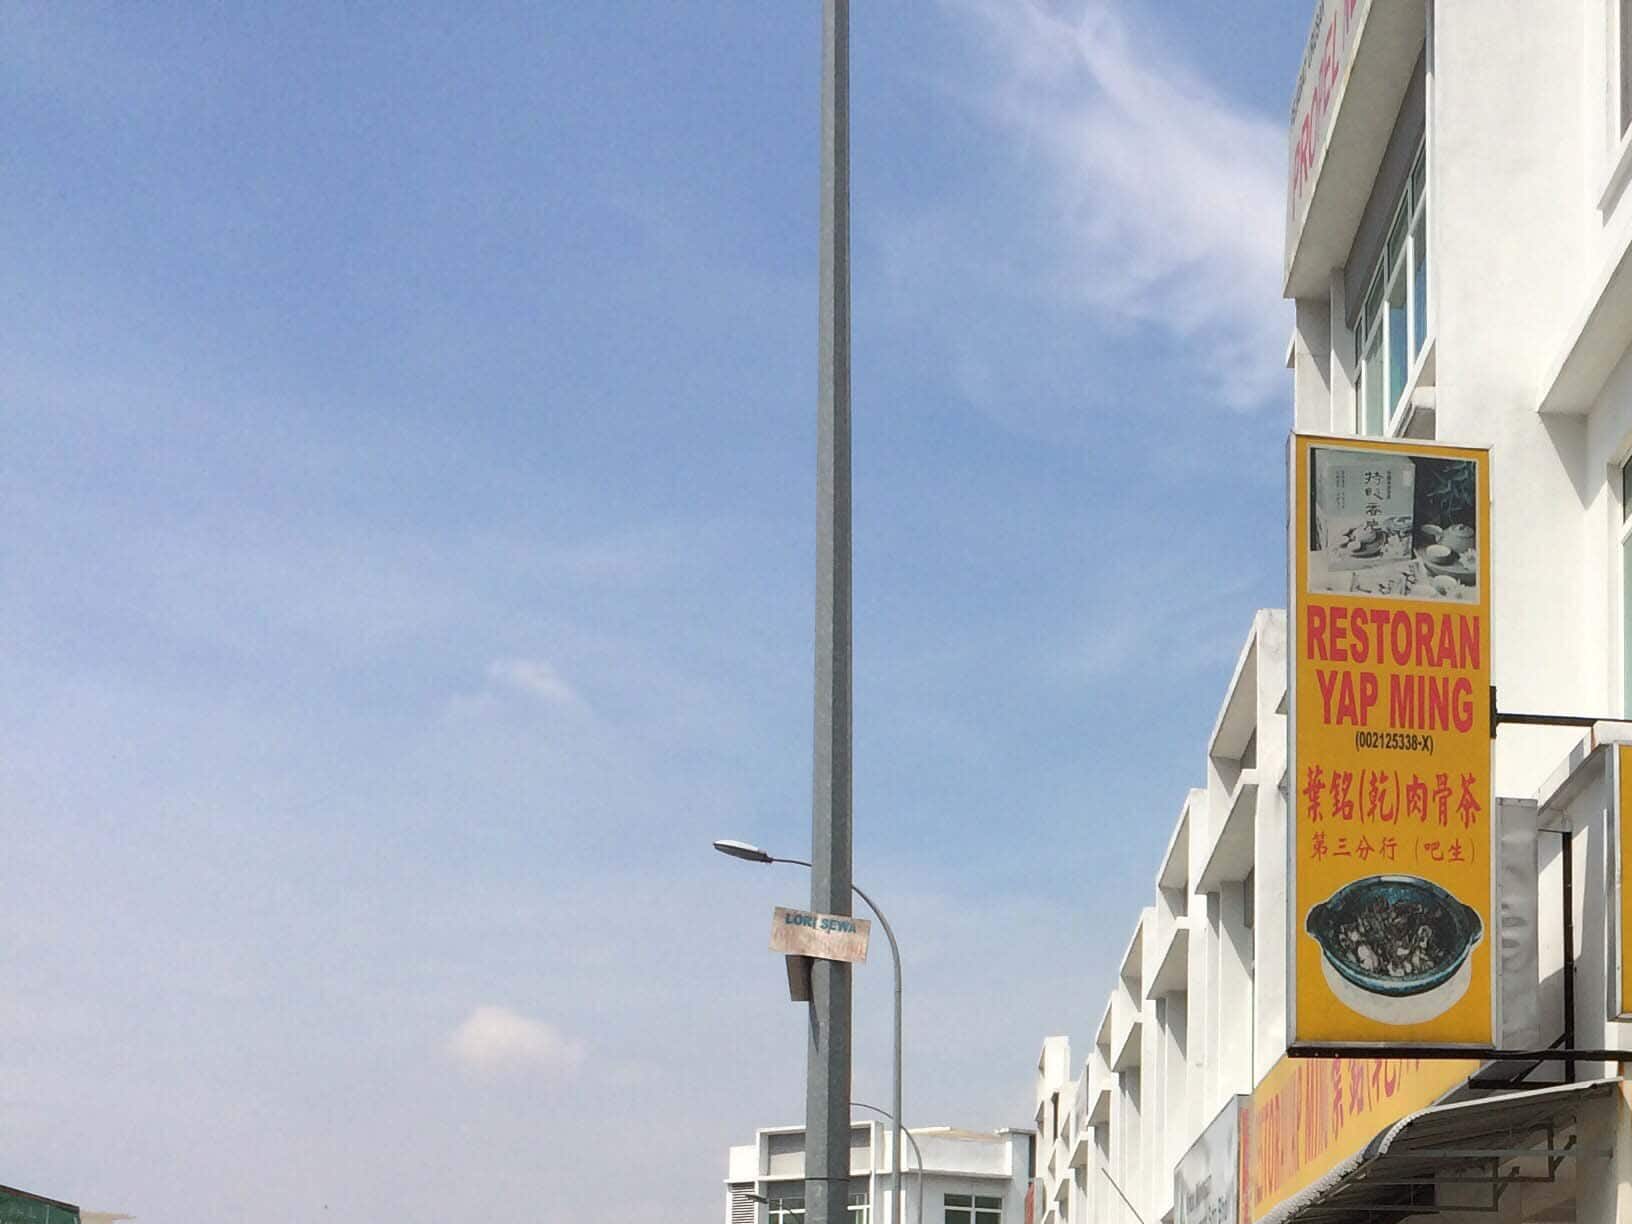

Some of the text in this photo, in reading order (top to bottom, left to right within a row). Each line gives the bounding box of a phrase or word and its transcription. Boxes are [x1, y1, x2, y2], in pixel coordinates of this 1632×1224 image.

[1307, 605, 1481, 670] RESTORAN
[1317, 669, 1474, 733] YAP MING
[1355, 731, 1434, 756] (002125338-X)
[785, 914, 857, 934] LORI SEWA
